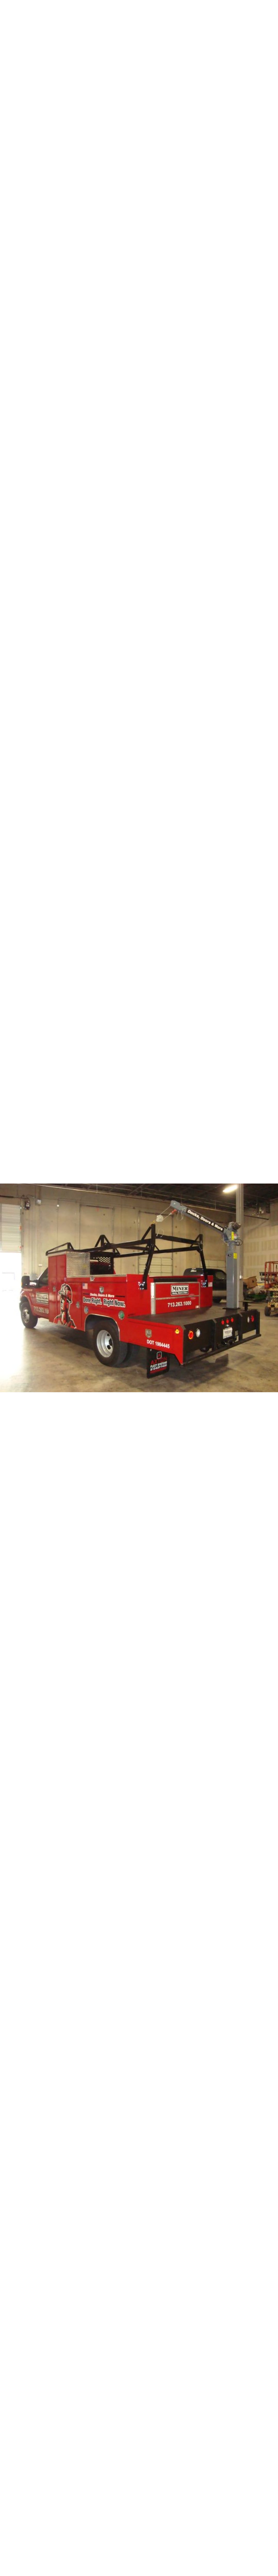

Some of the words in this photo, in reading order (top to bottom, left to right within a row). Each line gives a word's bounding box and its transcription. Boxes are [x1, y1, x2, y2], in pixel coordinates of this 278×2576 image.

[187, 1209, 199, 1219] Docks,
[103, 1298, 114, 1307] Right
[114, 1299, 126, 1307] Now.
